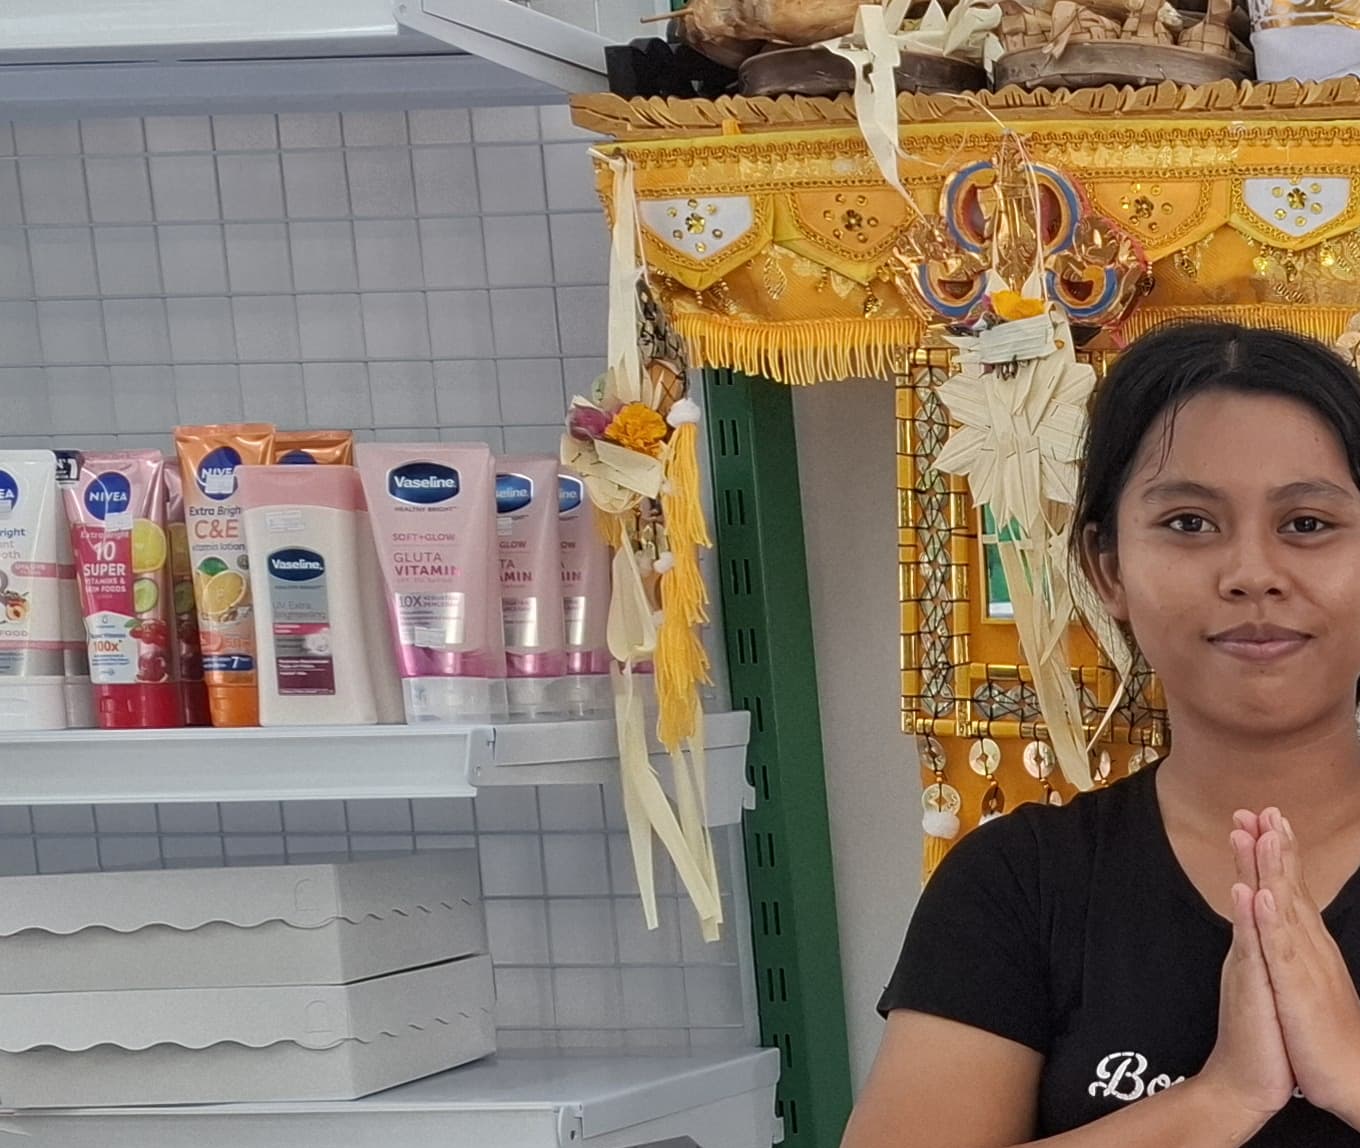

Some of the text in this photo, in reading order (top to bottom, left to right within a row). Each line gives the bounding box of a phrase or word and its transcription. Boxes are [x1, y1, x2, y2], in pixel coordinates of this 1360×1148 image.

[394, 475, 456, 488] Vaseline
[89, 491, 127, 502] NIVEA
[189, 506, 241, 518] Extra Brigh
[0, 528, 25, 537] right
[194, 519, 239, 539] C&E
[94, 541, 116, 560] 10
[393, 552, 442, 563] GLUTA
[84, 564, 125, 576] SUPER
[272, 558, 323, 570] Vaseline
